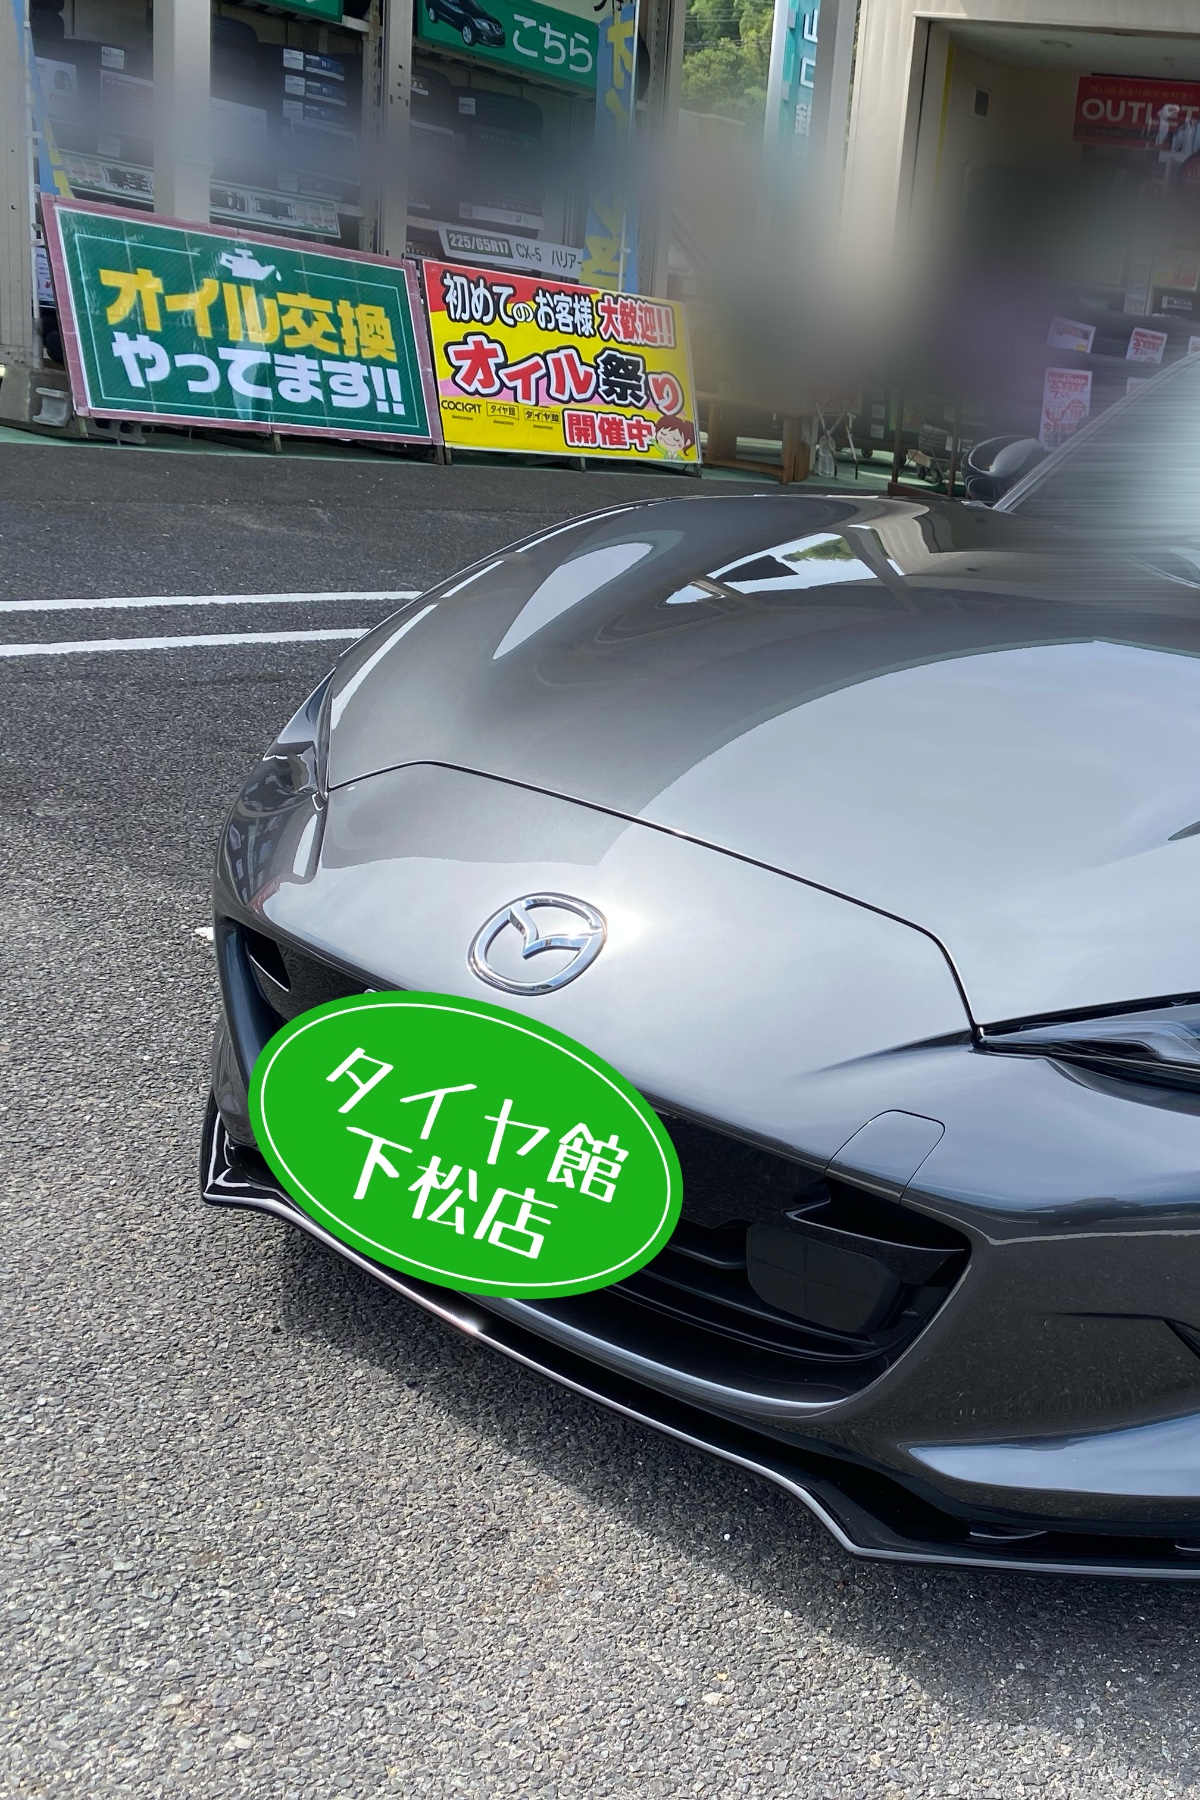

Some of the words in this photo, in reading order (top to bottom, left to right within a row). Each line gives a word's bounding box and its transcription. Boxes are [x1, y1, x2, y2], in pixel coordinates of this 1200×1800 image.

[512, 13, 593, 73] こちら
[1081, 98, 1199, 127] OUTLET
[449, 233, 510, 255] 225/65R17
[515, 243, 542, 262] CX-5
[99, 268, 398, 362] オイル交換
[444, 272, 595, 336] 初めてのお客様
[111, 331, 406, 416] やってます!!
[449, 337, 682, 414] オイル祭り
[441, 400, 482, 414] COCKPIT
[490, 405, 516, 416] タイヤ館
[525, 410, 560, 423] タイヤ館
[565, 410, 655, 450] 開催中
